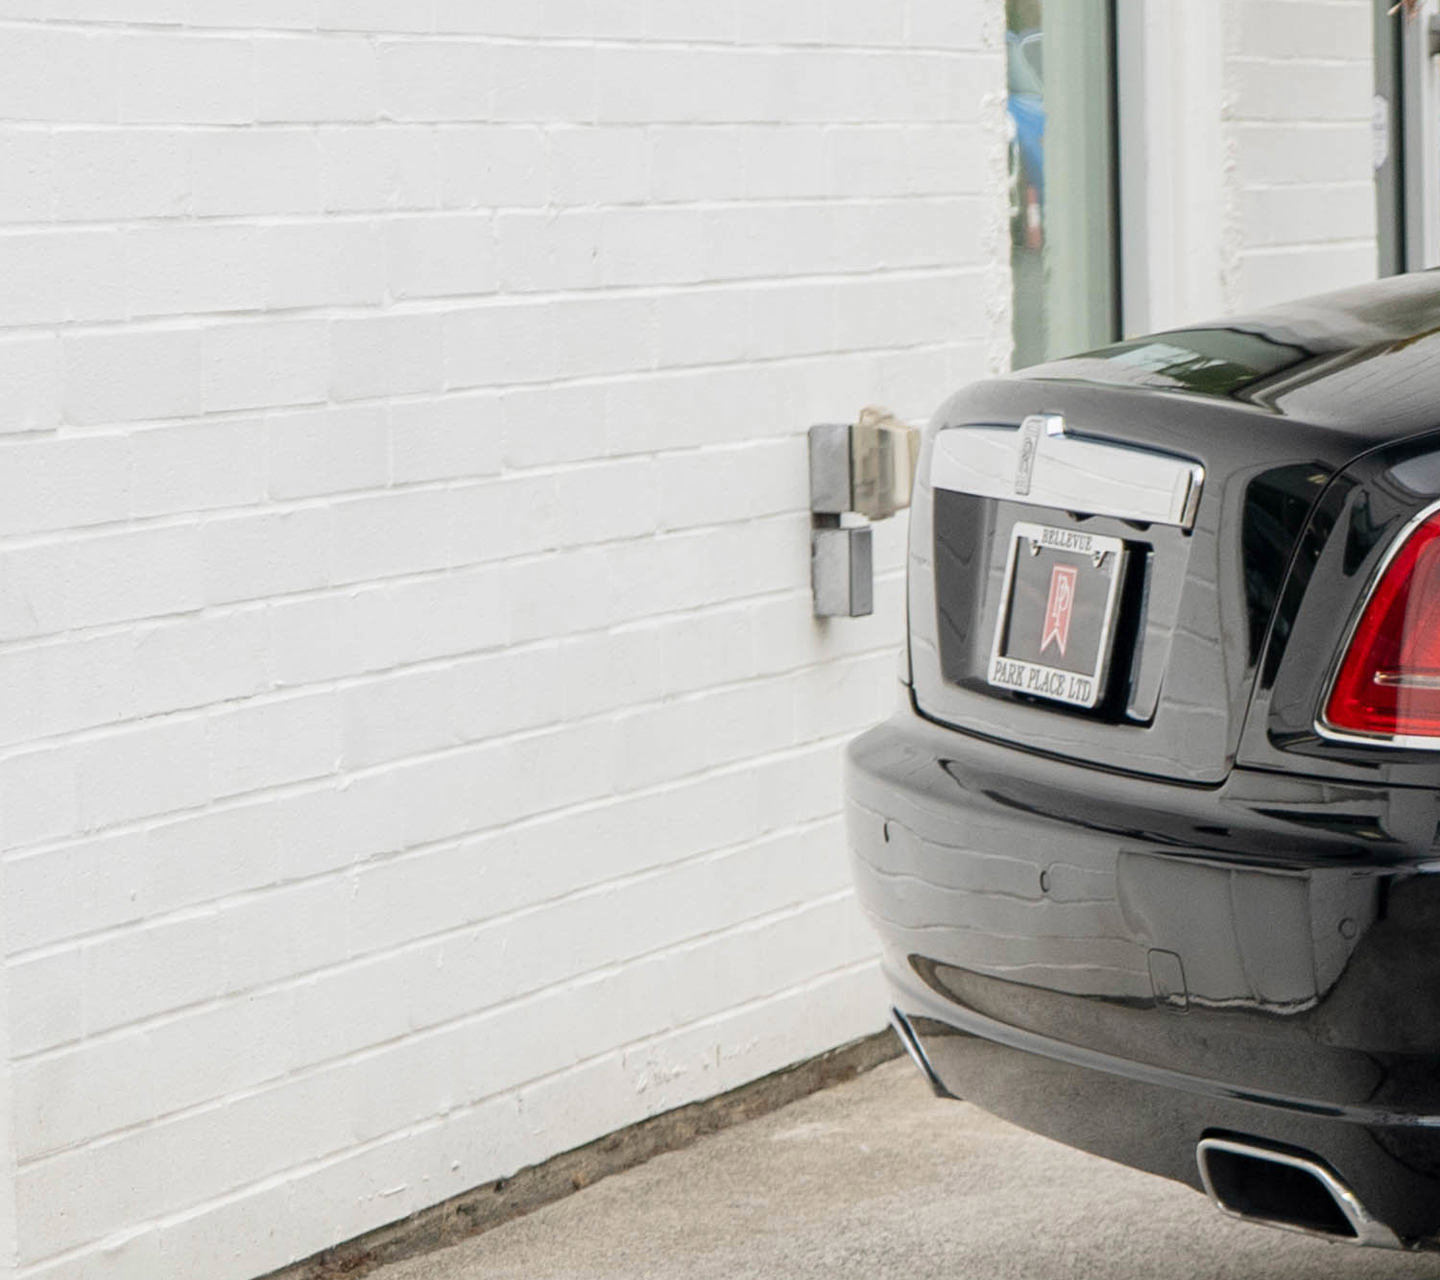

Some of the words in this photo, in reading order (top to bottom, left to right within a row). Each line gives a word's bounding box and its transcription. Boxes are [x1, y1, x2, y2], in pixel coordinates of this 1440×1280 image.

[1041, 528, 1093, 552] BELLEVUE
[992, 660, 1026, 686] PARK
[1027, 666, 1066, 696] PLACE
[1067, 677, 1093, 703] LTD
